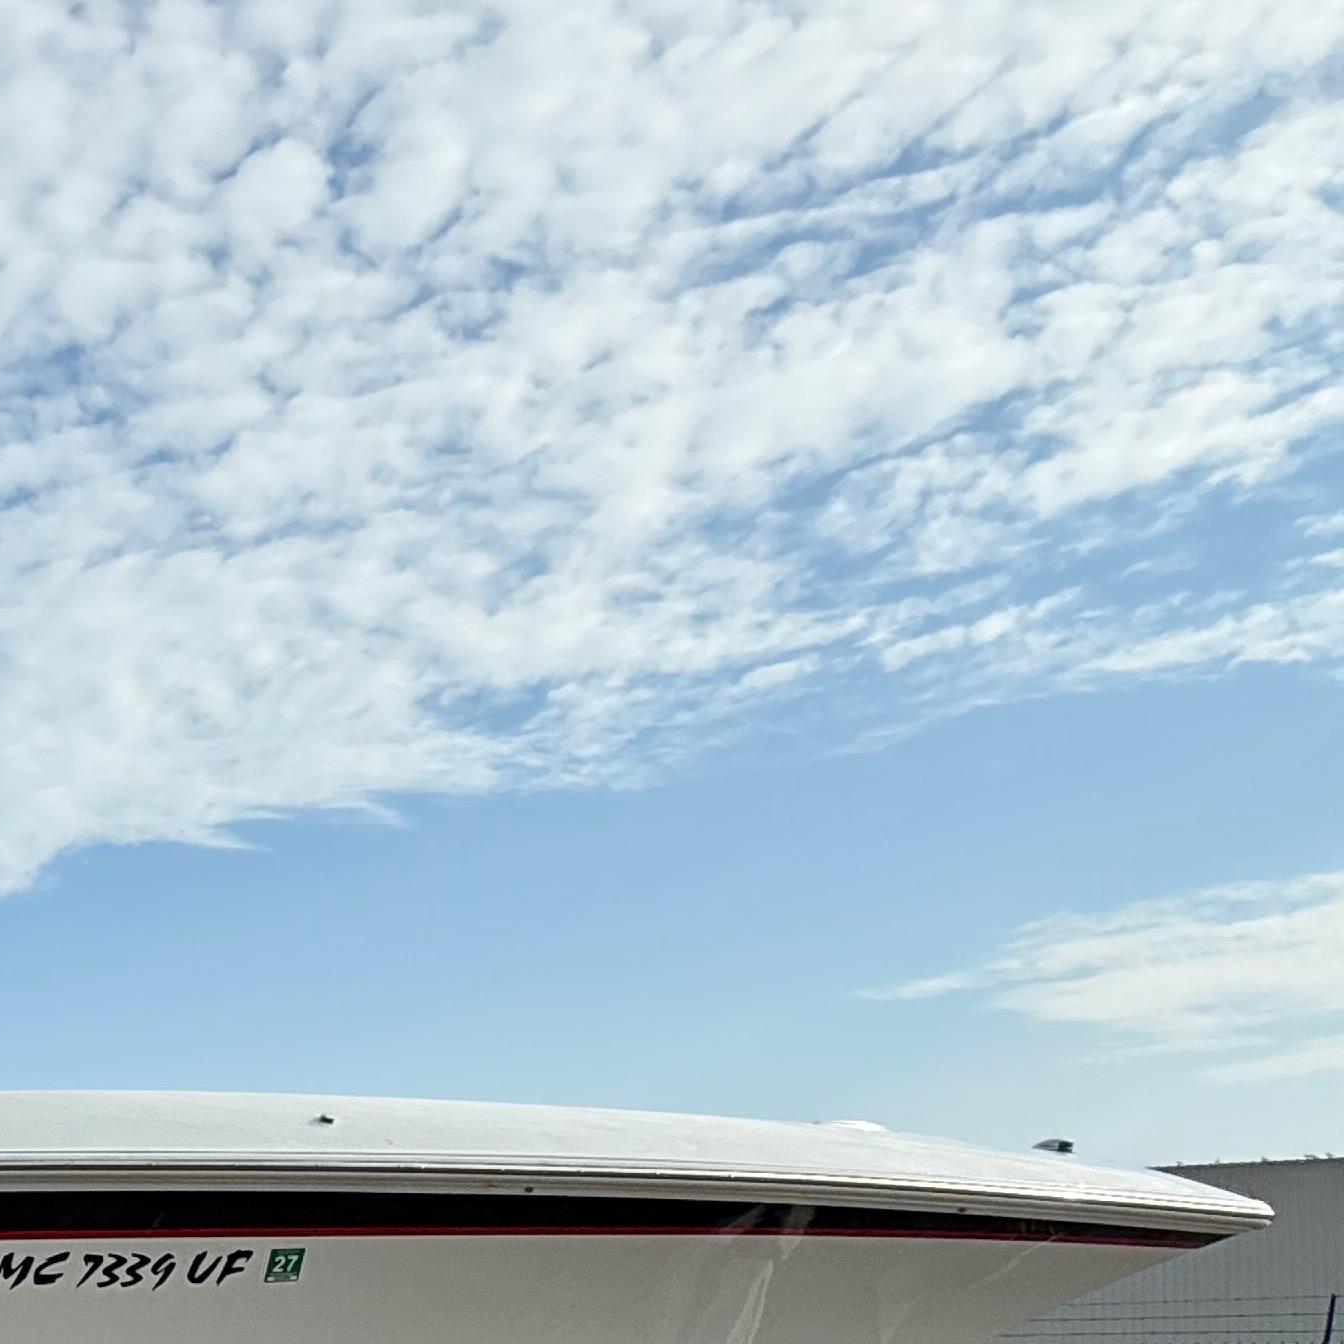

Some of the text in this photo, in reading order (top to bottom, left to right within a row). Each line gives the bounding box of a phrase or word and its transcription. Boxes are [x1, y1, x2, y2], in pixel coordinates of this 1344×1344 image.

[76, 1252, 176, 1291] 7339
[186, 1250, 253, 1287] UF
[272, 1254, 300, 1272] 27
